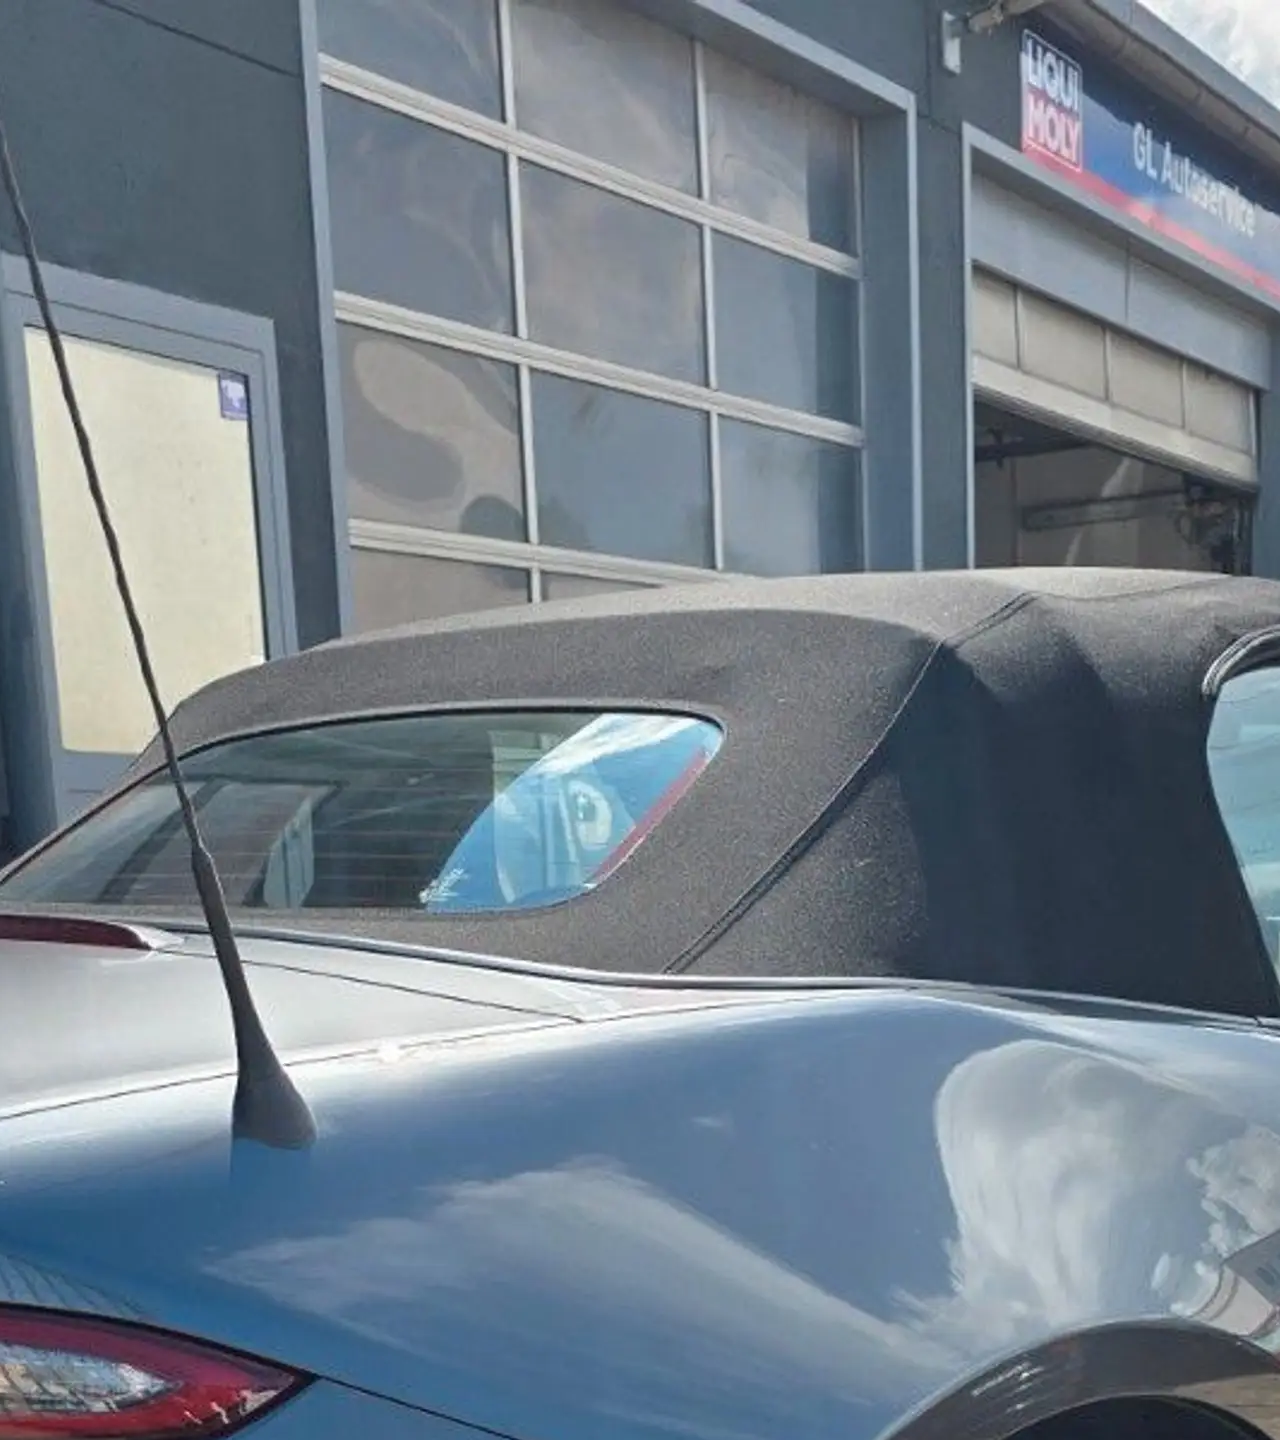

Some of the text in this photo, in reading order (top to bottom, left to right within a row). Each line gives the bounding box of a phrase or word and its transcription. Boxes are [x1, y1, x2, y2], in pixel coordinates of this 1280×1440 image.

[1026, 38, 1080, 112] LIQUI
[1027, 92, 1080, 162] MOLY
[1132, 121, 1158, 180] GL
